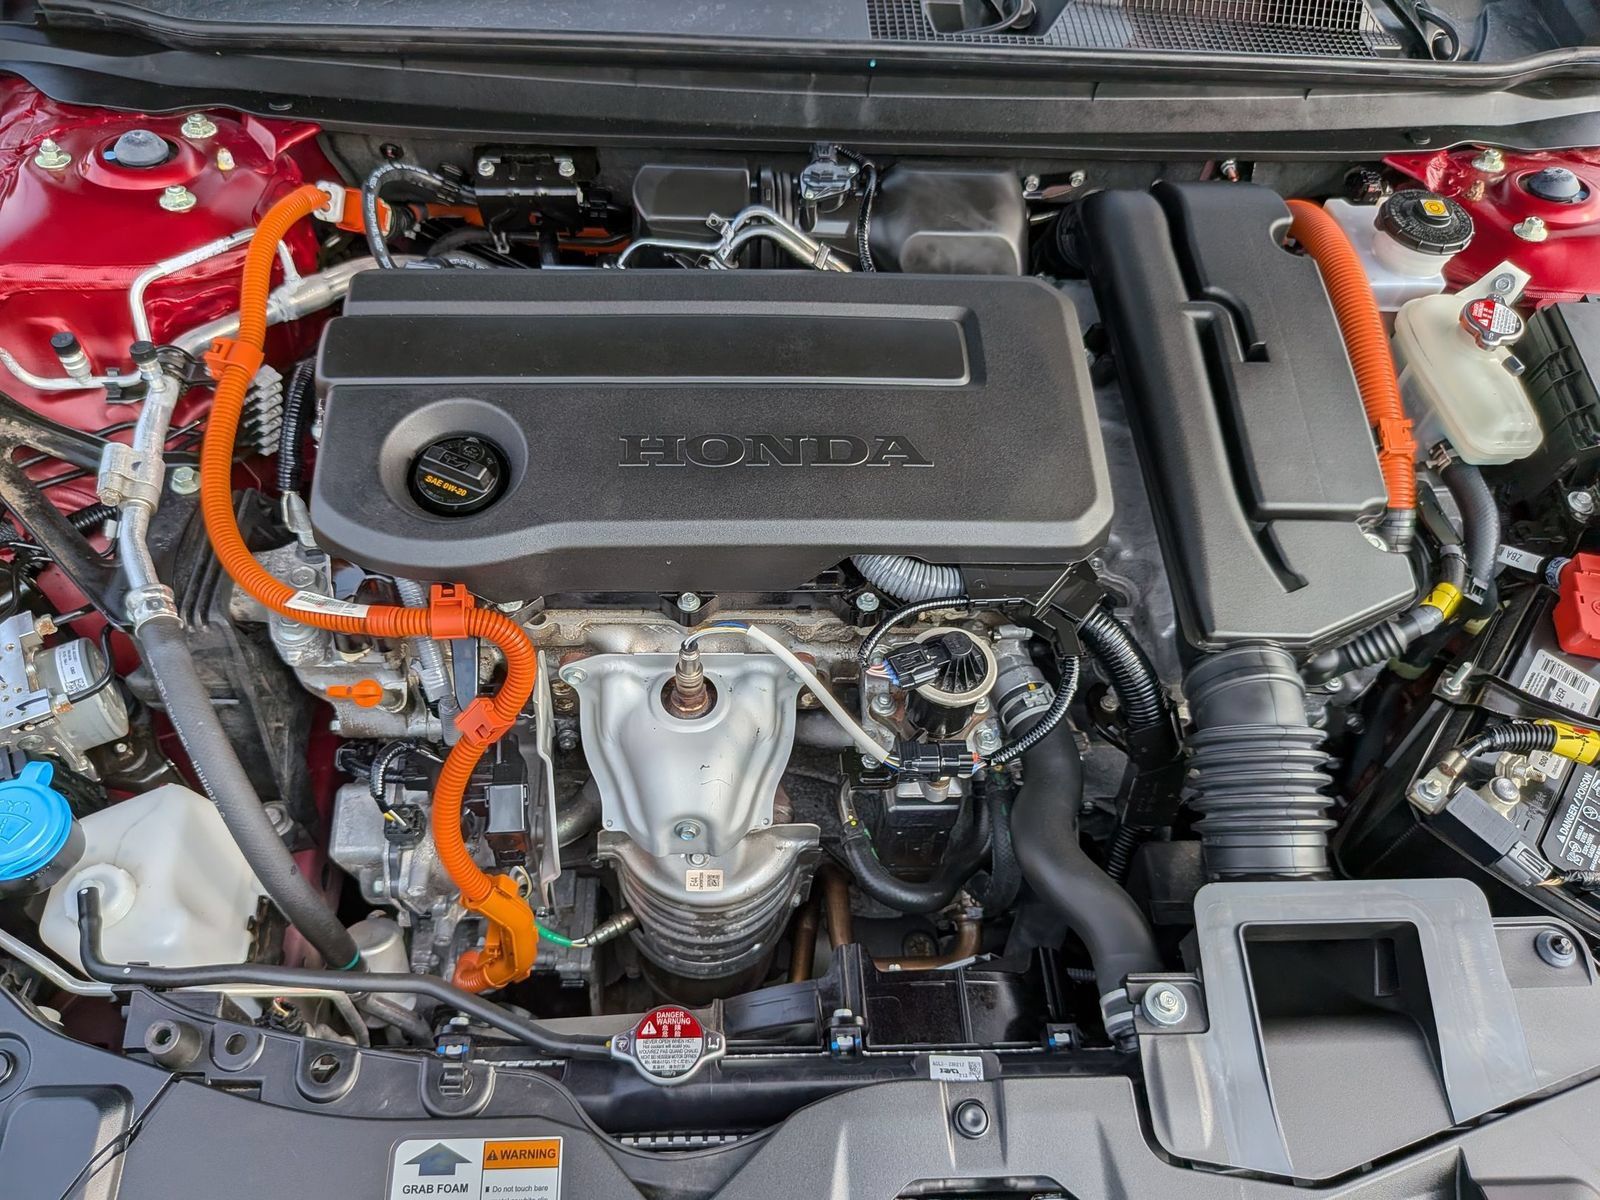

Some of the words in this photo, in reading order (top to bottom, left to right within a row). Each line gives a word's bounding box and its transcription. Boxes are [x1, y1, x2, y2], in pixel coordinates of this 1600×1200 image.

[618, 433, 935, 467] HONDA
[424, 475, 444, 487] SAE
[442, 482, 467, 496] 0W-20
[656, 1017, 691, 1025] WARNUNG
[500, 1148, 556, 1160] WARNING
[402, 1184, 434, 1194] GRAB
[437, 1183, 469, 1194] FOAM
